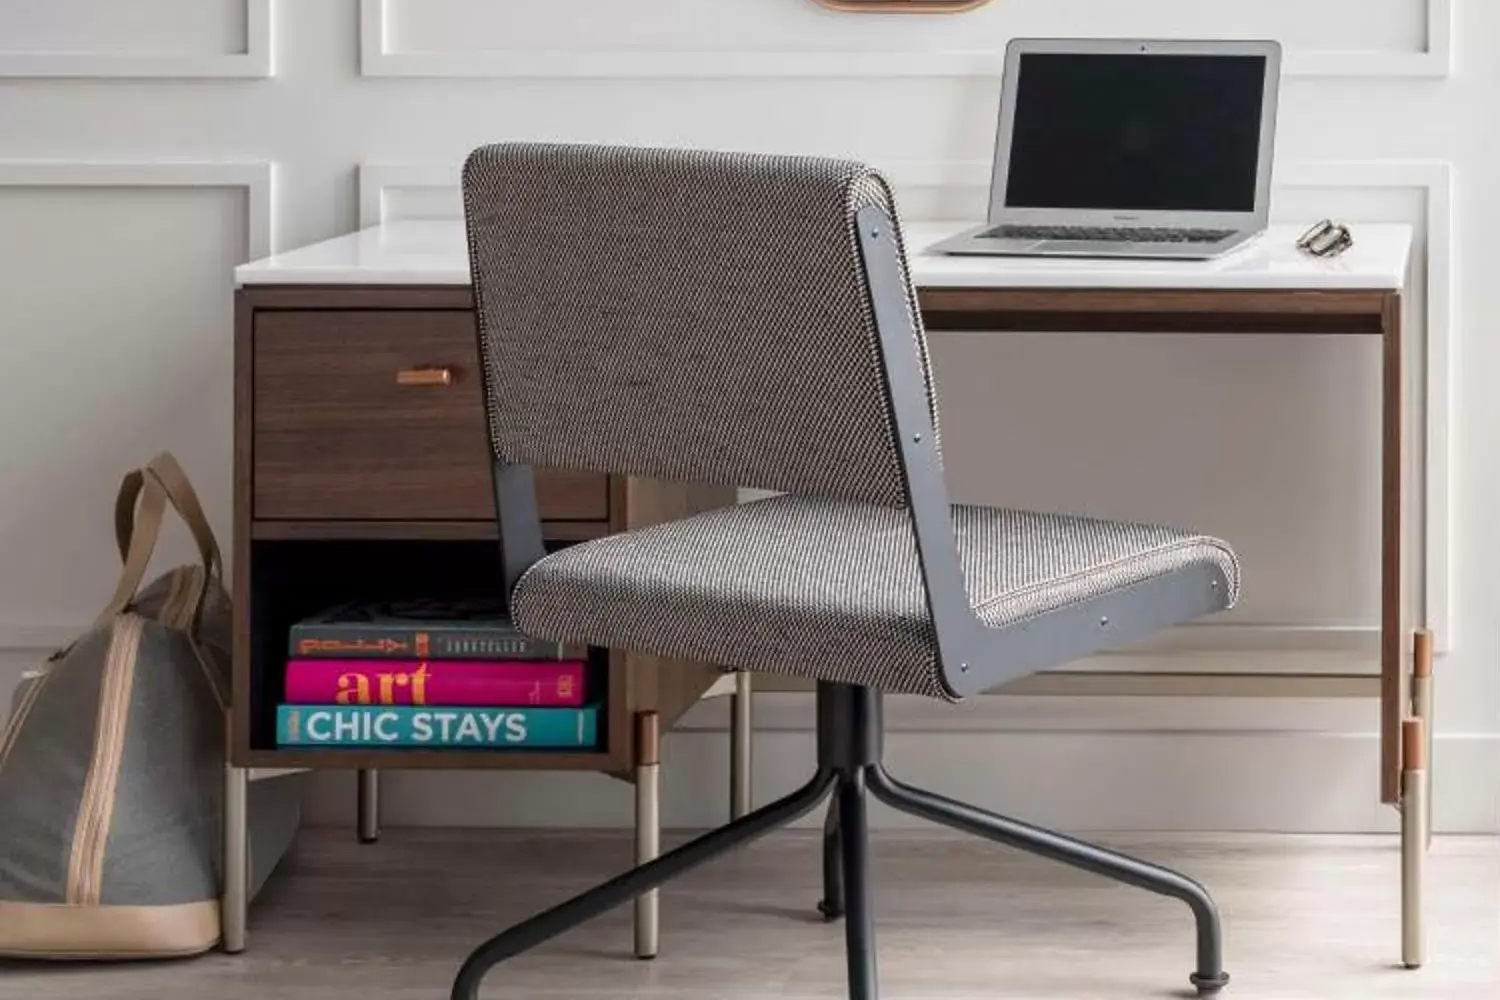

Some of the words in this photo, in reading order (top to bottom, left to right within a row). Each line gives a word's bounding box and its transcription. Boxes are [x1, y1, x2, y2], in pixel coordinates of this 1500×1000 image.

[336, 662, 432, 705] art
[306, 711, 399, 741] CHIC
[411, 712, 528, 742] STAYS
